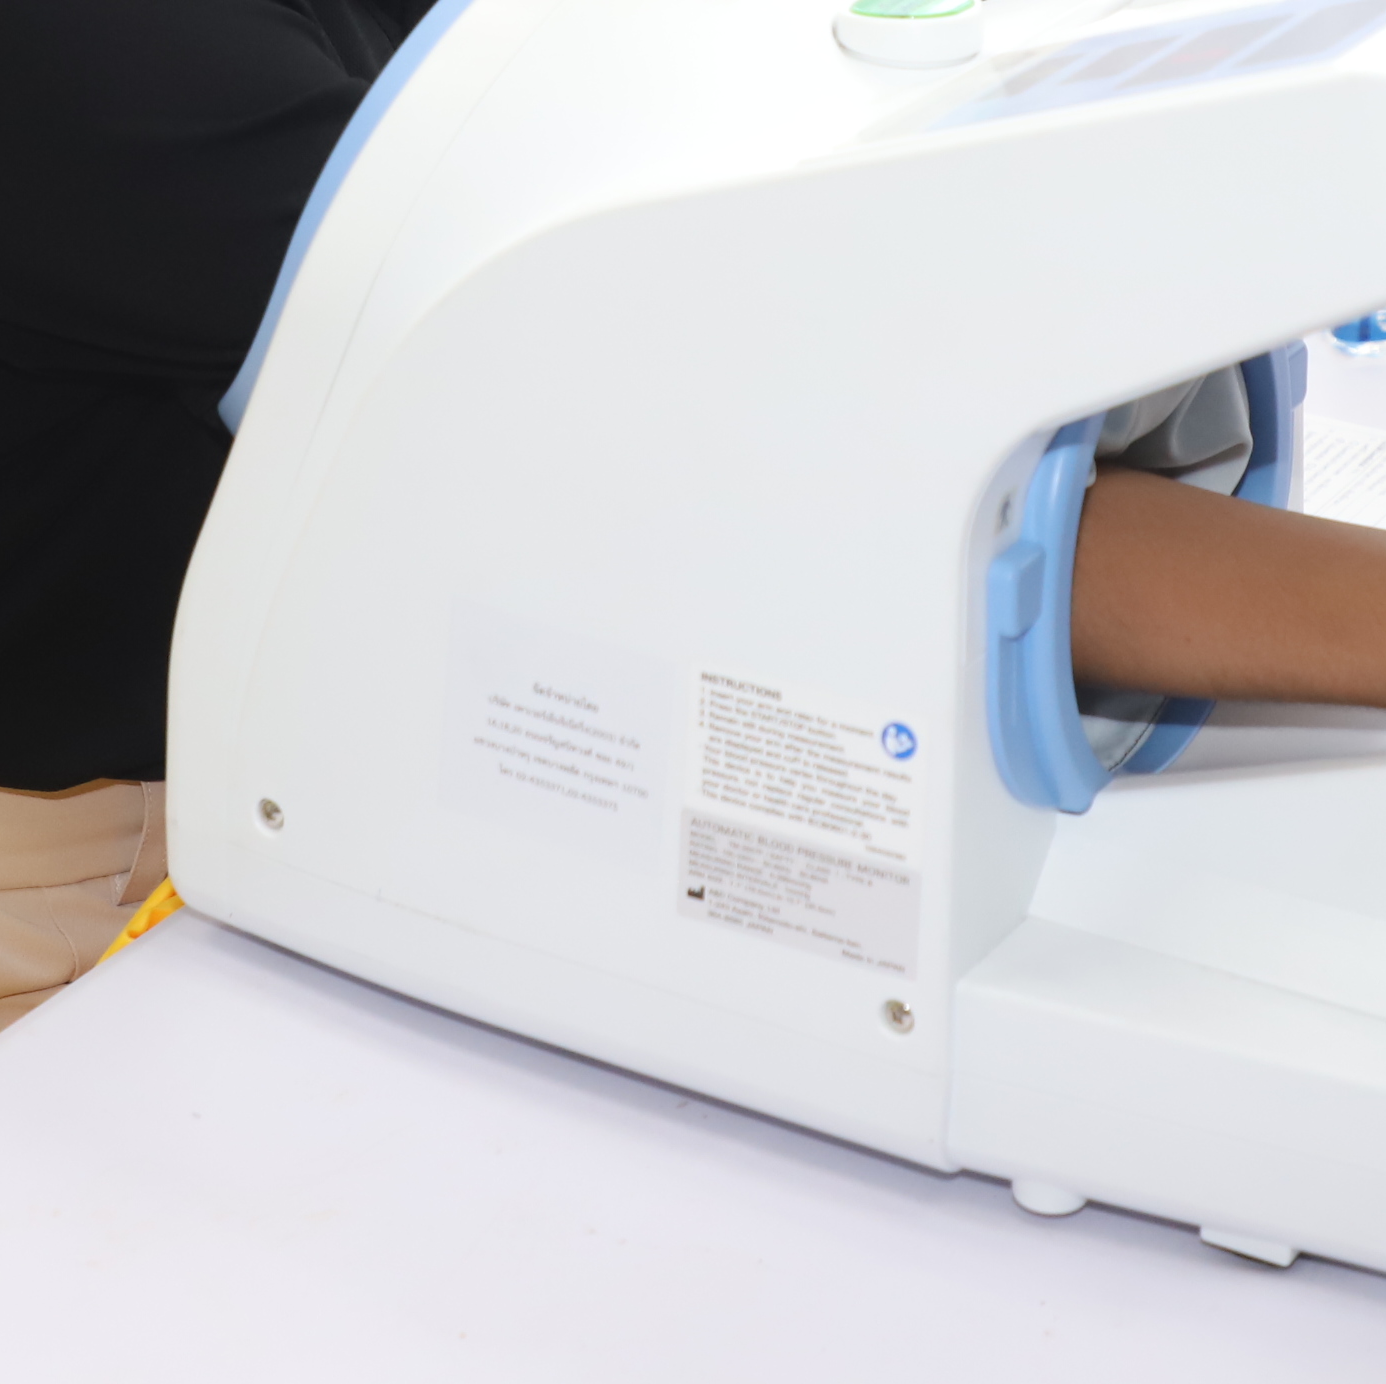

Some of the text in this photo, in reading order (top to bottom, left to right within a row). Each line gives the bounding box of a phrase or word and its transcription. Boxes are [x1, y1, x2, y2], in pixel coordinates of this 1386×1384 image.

[701, 672, 782, 701] INSTRUCTIONS
[690, 817, 753, 841] AUTOMATIC
[757, 835, 795, 853] BLOOD
[797, 846, 852, 870] PRESSURE
[857, 864, 911, 885] MONITOR
